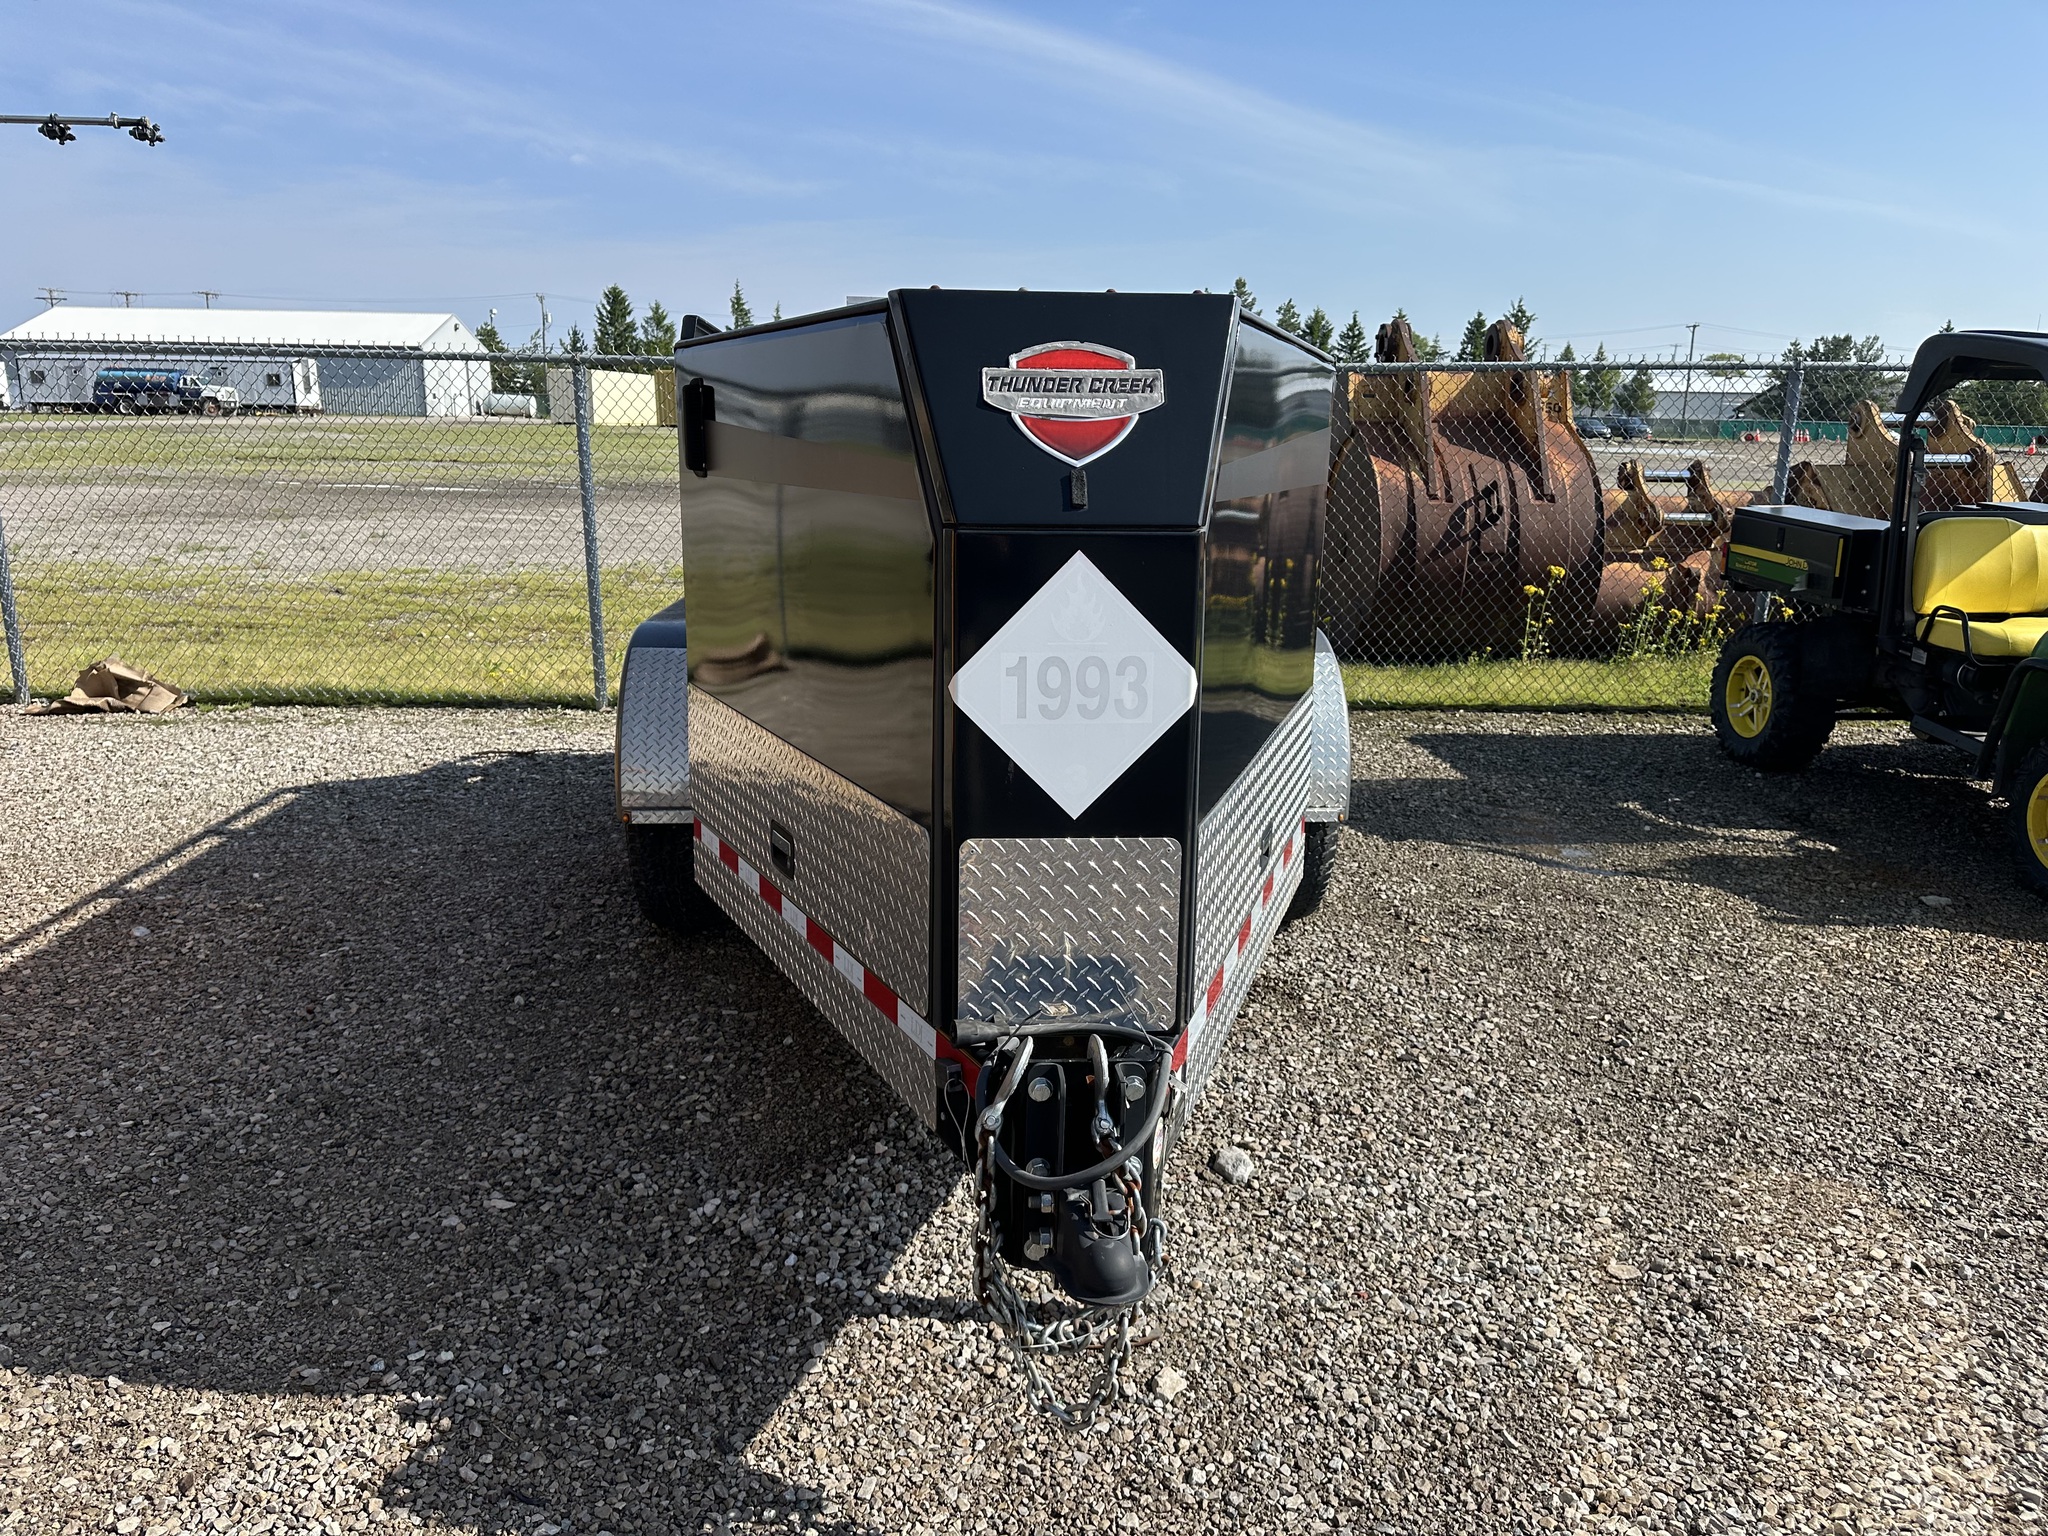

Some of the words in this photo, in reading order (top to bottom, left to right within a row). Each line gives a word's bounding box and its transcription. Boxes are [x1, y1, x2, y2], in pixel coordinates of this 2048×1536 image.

[988, 376, 1083, 393] THUNDER
[1088, 377, 1156, 394] CREEK
[1017, 397, 1128, 409] EQUIPMENT
[1785, 557, 1802, 568] JOHN
[1005, 655, 1148, 720] 1993
